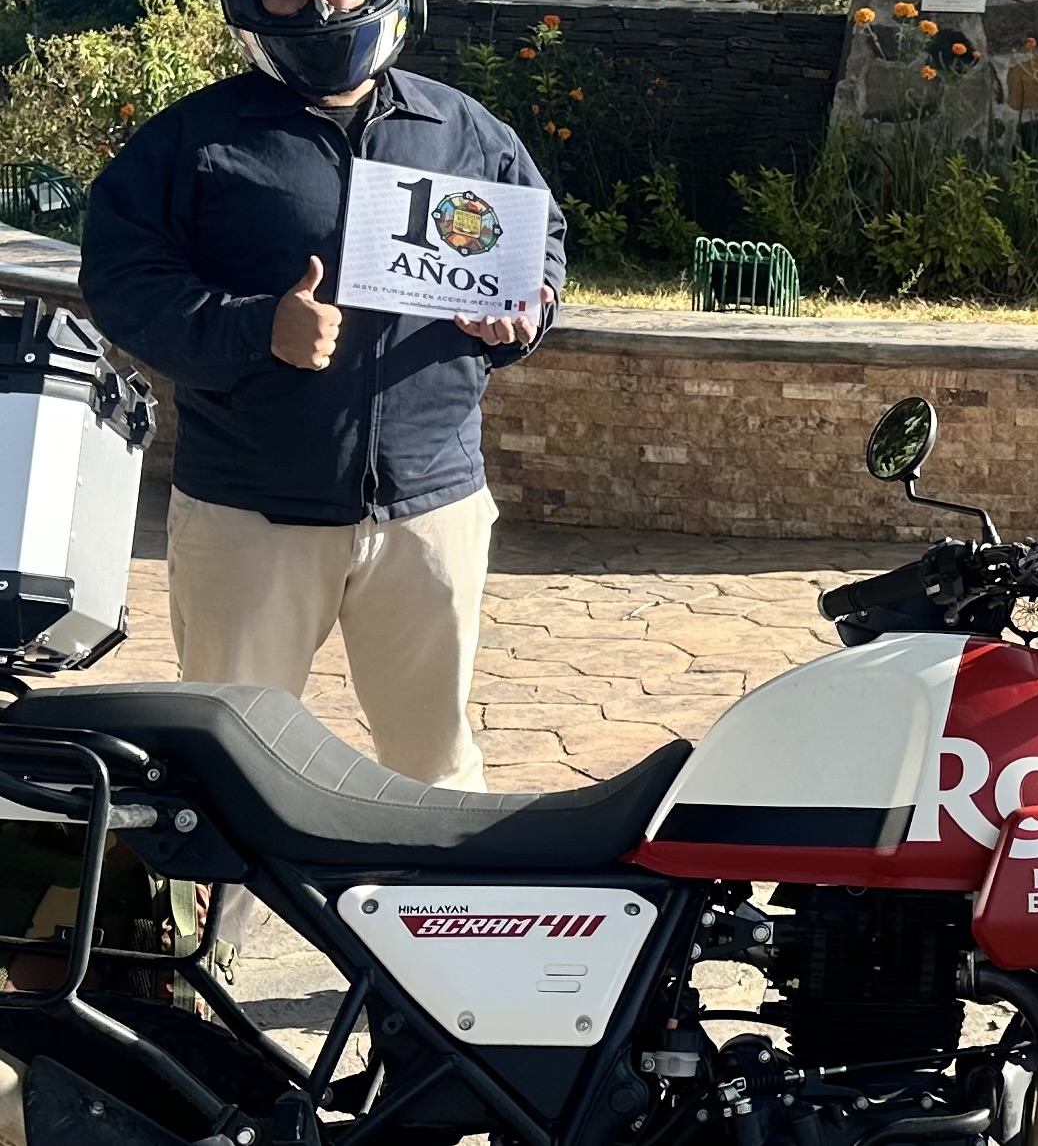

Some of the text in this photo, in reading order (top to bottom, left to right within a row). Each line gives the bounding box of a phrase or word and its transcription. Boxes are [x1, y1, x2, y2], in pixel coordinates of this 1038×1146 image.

[386, 251, 499, 297] AÑOS
[398, 905, 469, 914] HIMALAYAN
[416, 915, 607, 937] SCRAM 411
